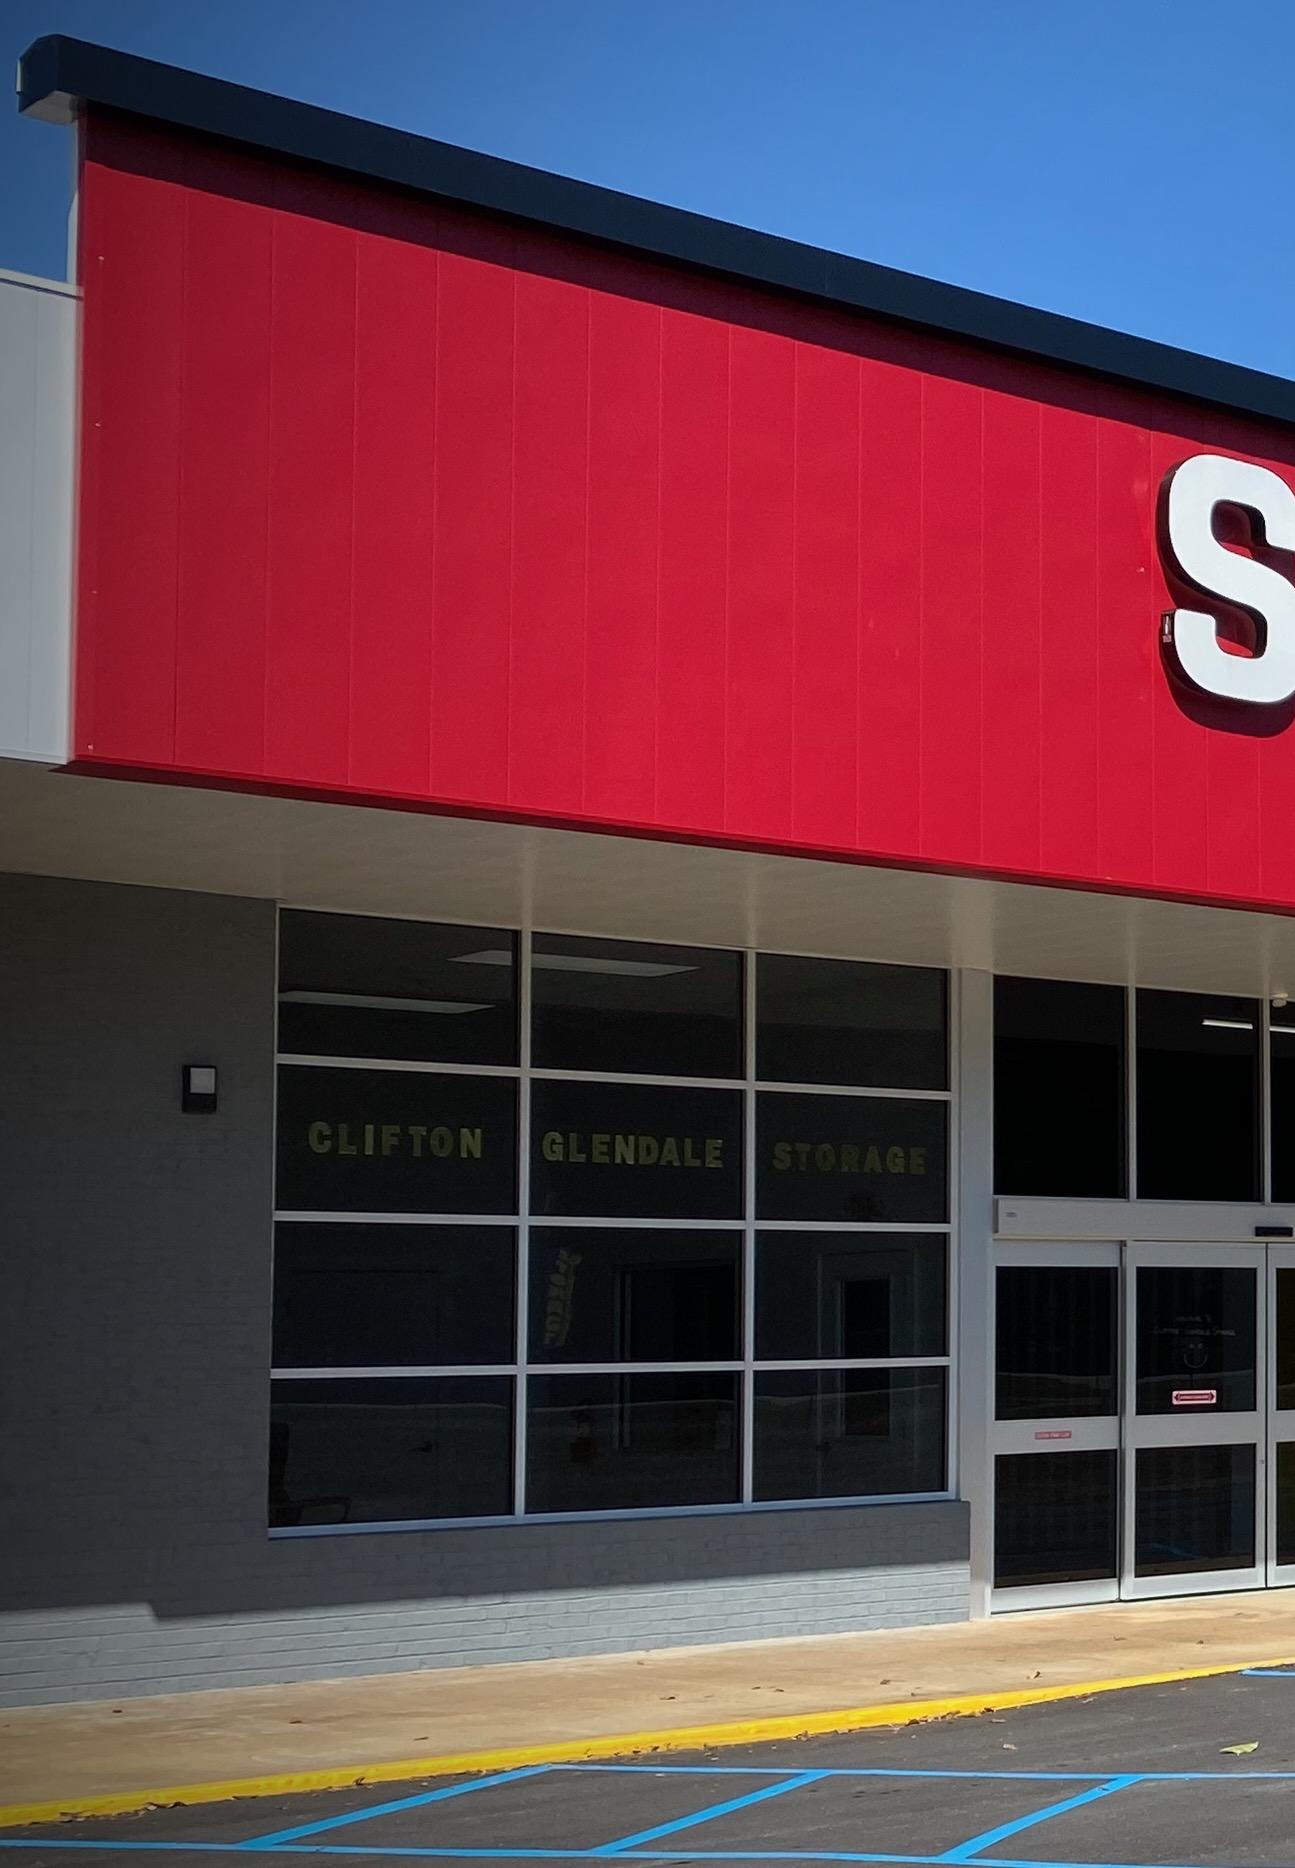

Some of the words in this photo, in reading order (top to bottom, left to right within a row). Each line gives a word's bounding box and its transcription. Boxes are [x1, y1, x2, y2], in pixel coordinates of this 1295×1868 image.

[307, 1121, 482, 1159] CLIFTON
[541, 1131, 724, 1169] GLENDALE
[772, 1141, 928, 1176] STORAGE
